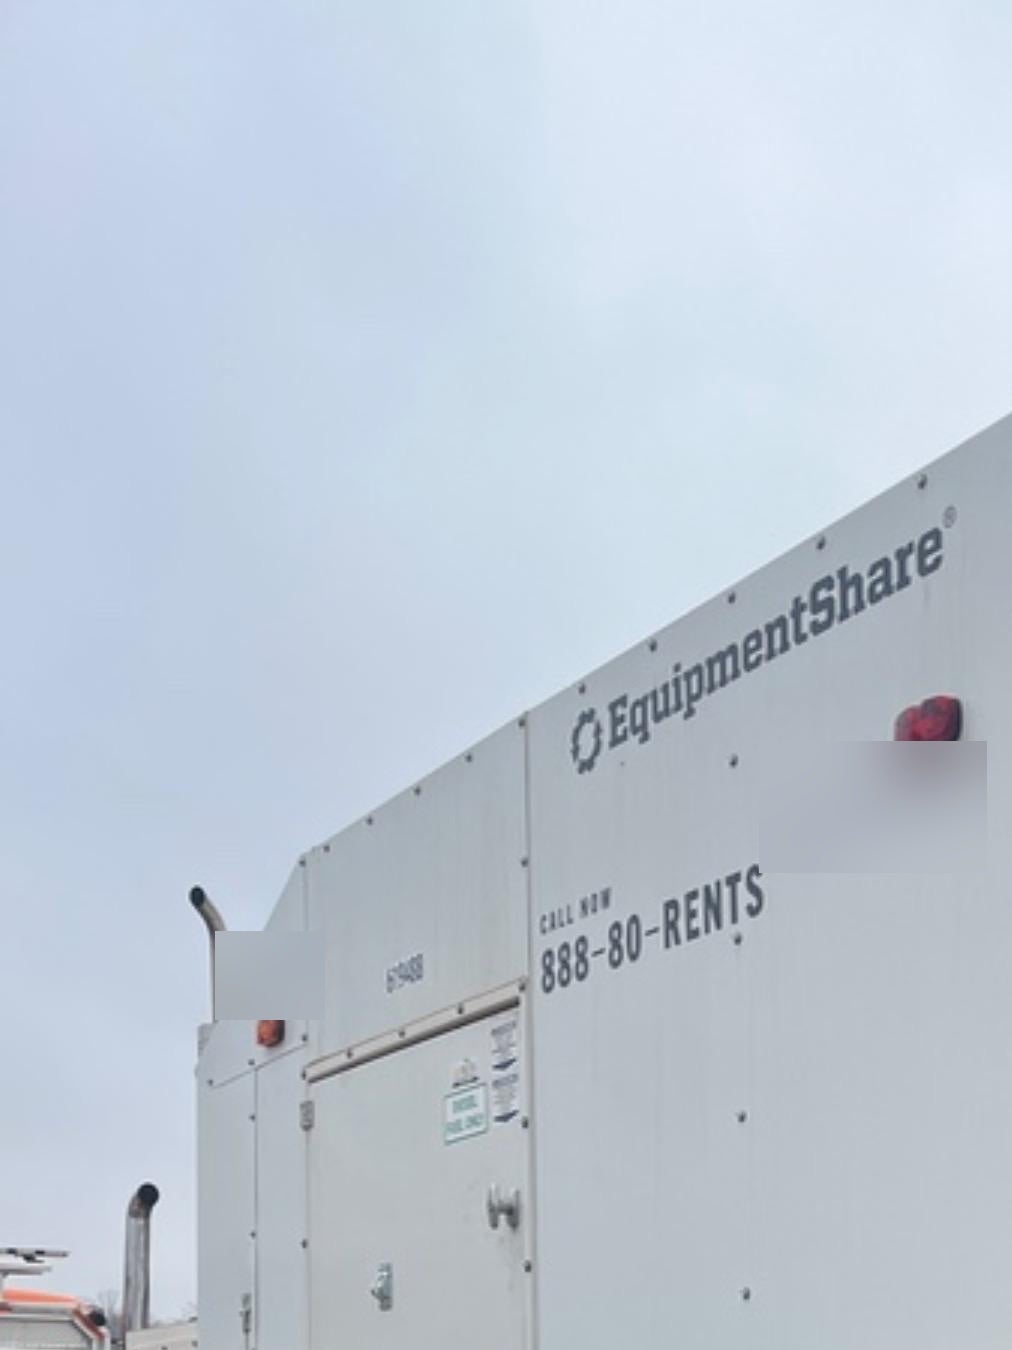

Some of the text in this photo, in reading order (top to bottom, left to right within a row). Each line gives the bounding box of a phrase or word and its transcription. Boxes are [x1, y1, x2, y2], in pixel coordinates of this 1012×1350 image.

[540, 886, 611, 935] CALL NOW
[541, 863, 764, 995] 888-80-RENTS
